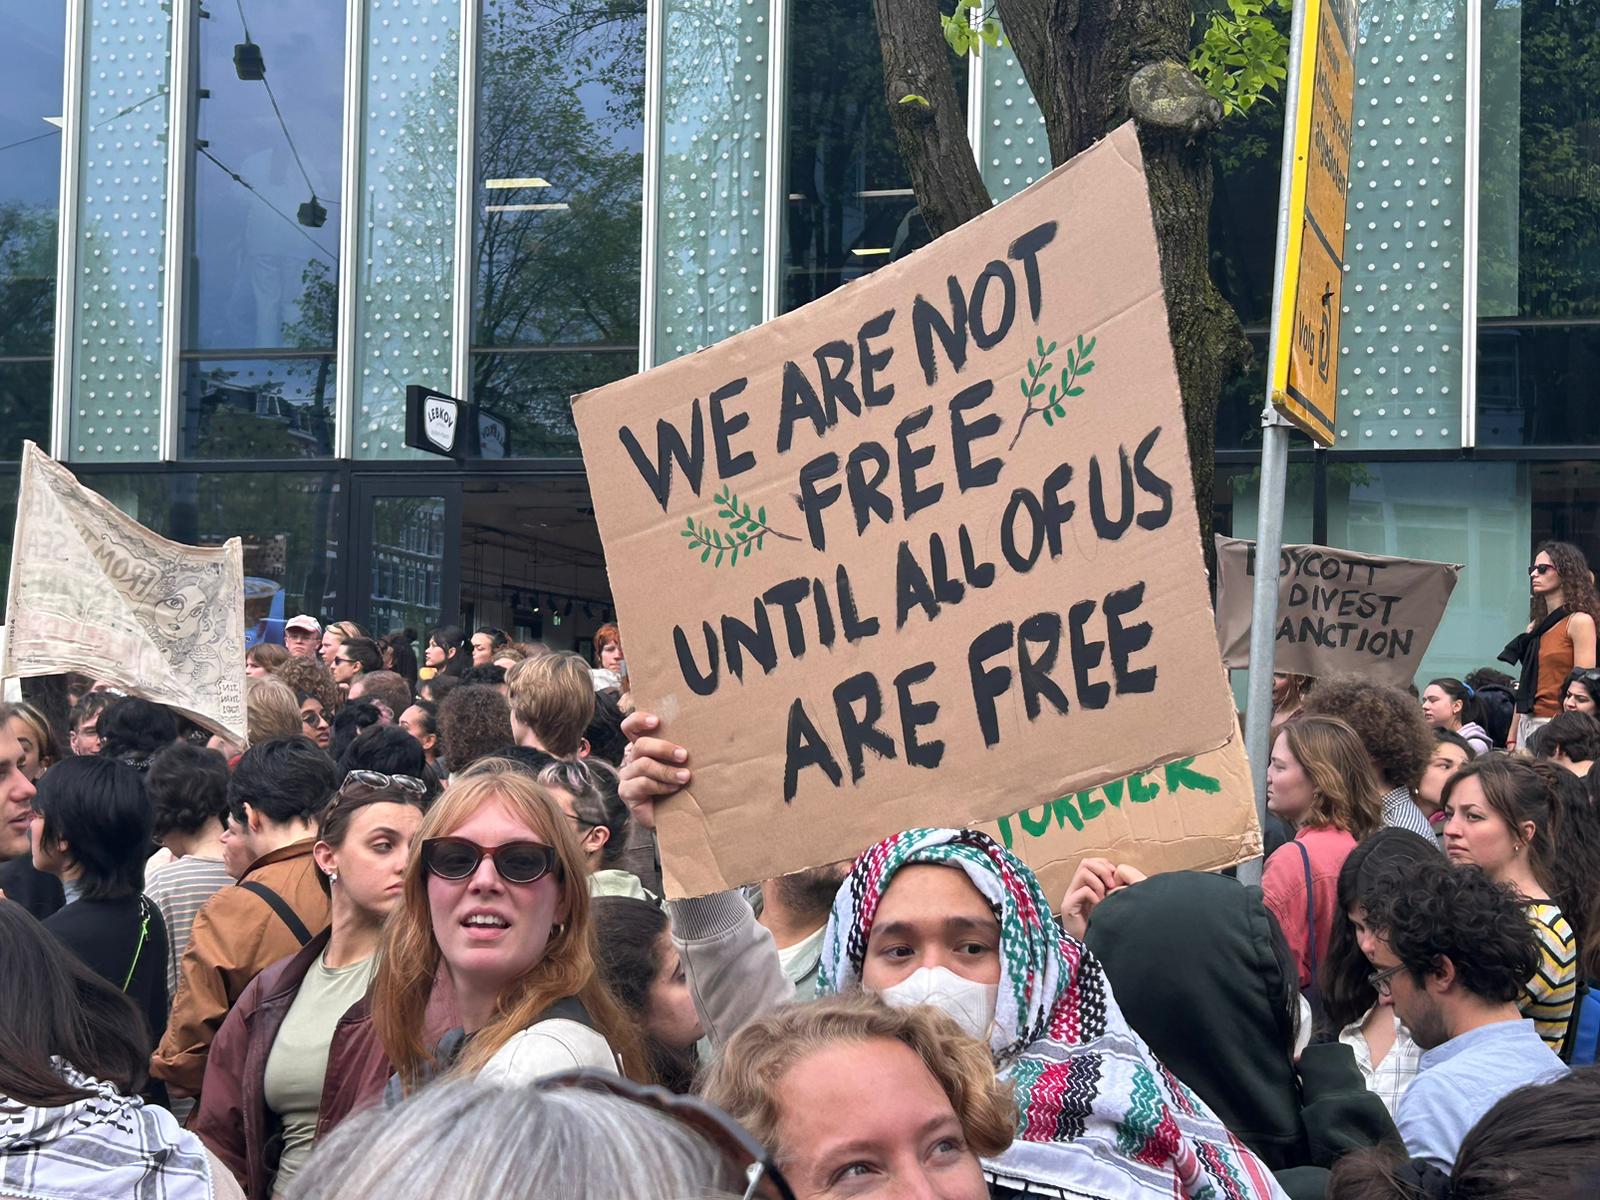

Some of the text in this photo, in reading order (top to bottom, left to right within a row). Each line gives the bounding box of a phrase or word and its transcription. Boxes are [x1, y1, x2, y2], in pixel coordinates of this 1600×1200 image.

[619, 221, 1057, 512] WE ARE NOT
[1298, 310, 1315, 365] Volg
[428, 407, 454, 428] LEBKOV
[797, 380, 1004, 551] FREE
[673, 427, 1172, 695] UNTIL ALL OF US
[1288, 584, 1402, 626] DIVEST
[784, 581, 1157, 804] ARE FREE
[1275, 616, 1414, 659] ANCTION
